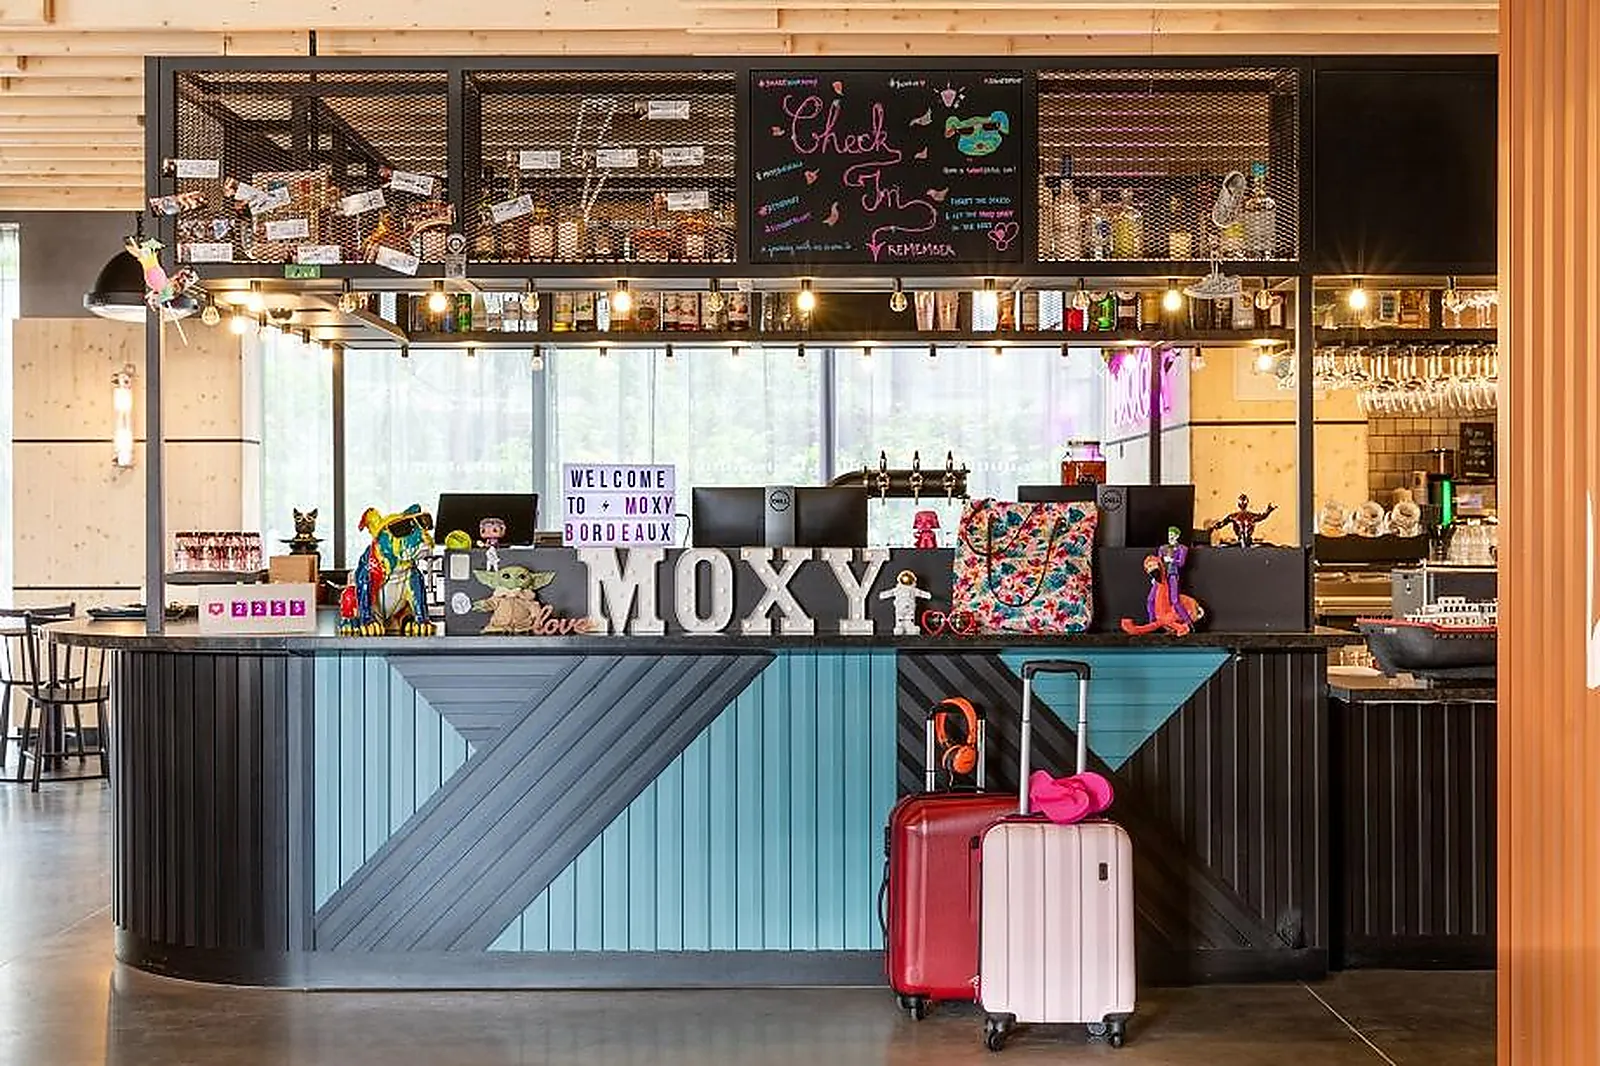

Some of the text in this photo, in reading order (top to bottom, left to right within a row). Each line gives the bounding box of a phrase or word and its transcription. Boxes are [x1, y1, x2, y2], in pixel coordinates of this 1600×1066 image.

[783, 95, 893, 154] Check
[858, 169, 901, 211] In
[888, 242, 956, 258] REMEMBER
[570, 470, 665, 488] WELCOME
[567, 496, 673, 515] TO MOXY
[565, 523, 671, 541] BORDEAUX
[577, 547, 891, 635] MOXY
[533, 604, 593, 635] love
